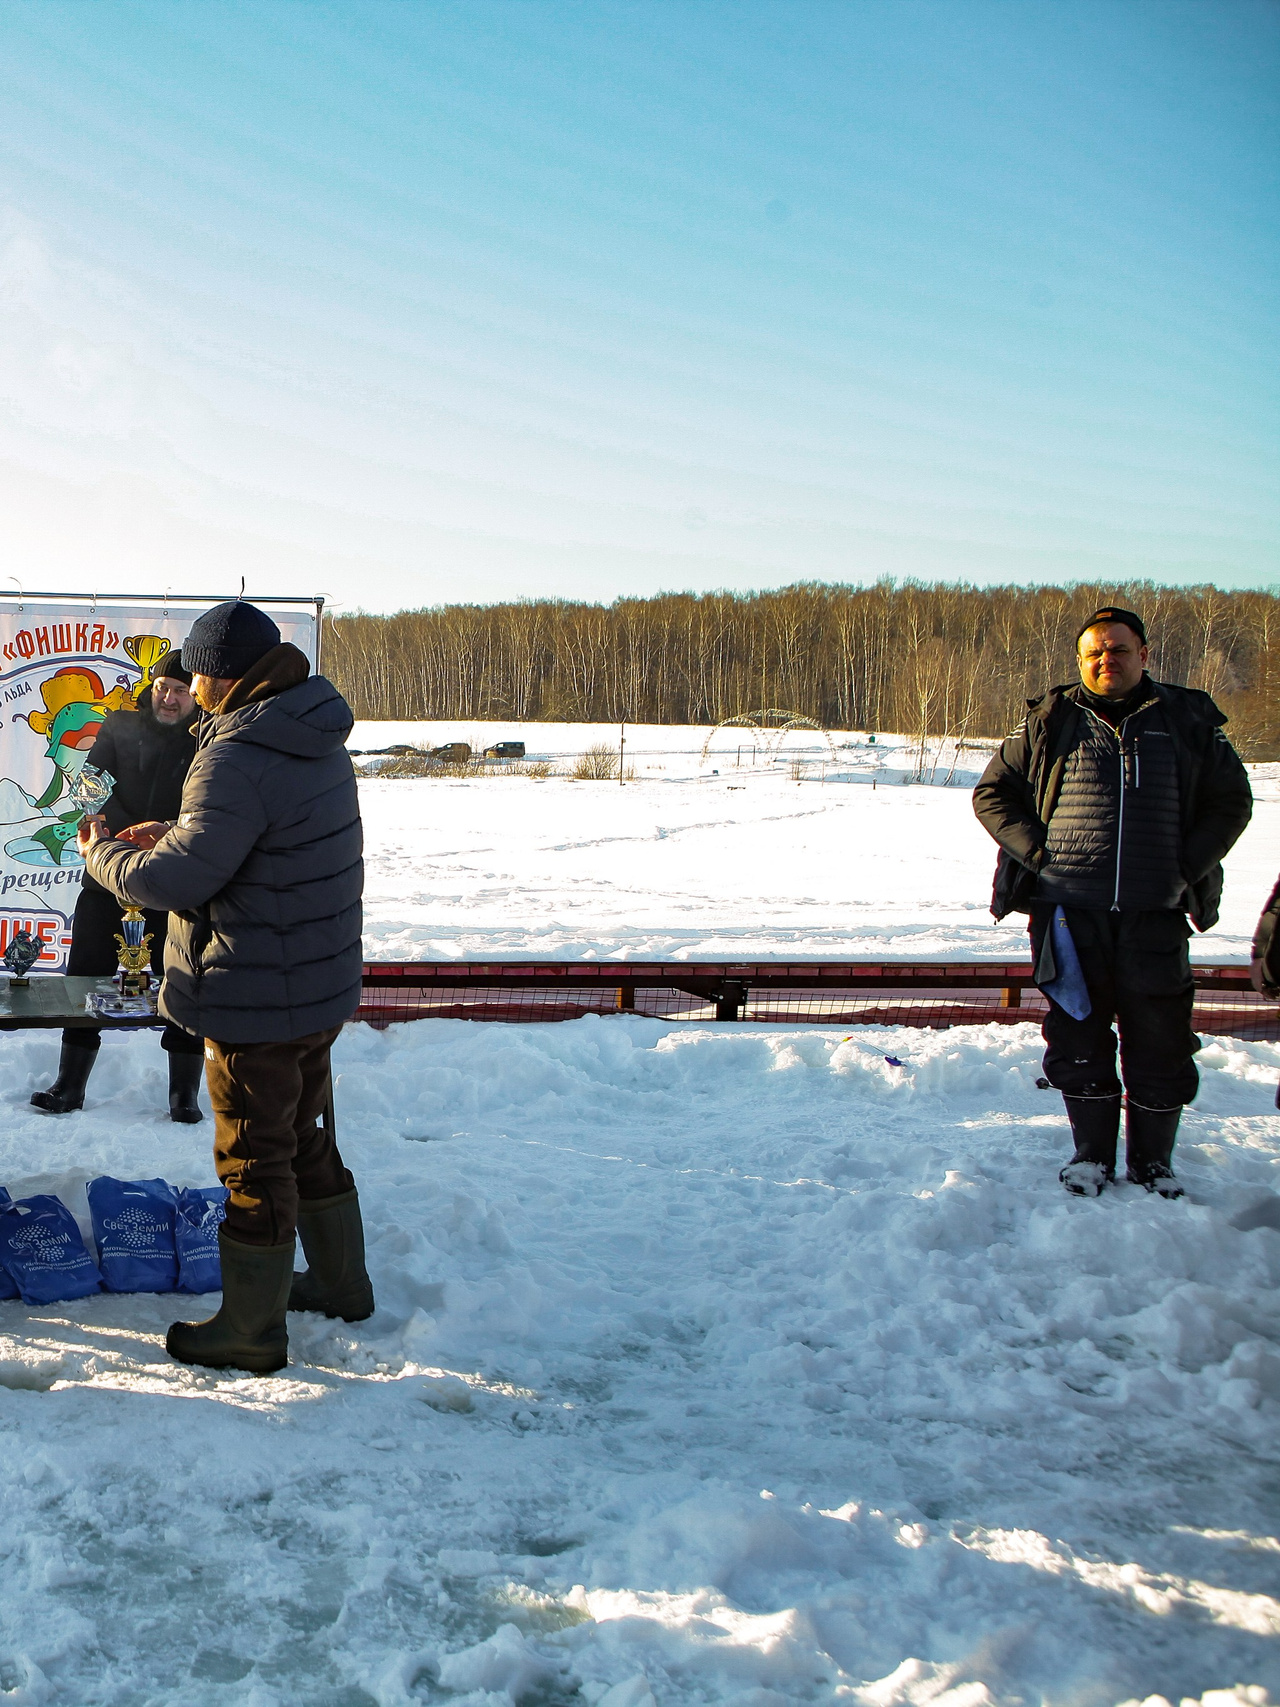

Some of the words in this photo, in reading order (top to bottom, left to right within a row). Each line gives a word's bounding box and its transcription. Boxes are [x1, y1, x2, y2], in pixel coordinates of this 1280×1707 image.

[2, 622, 120, 661] «ФИШКА»
[5, 681, 33, 703] ЛЬДА
[103, 1218, 129, 1231] Свет
[132, 1221, 169, 1233] Земли
[32, 1232, 72, 1249] Земли
